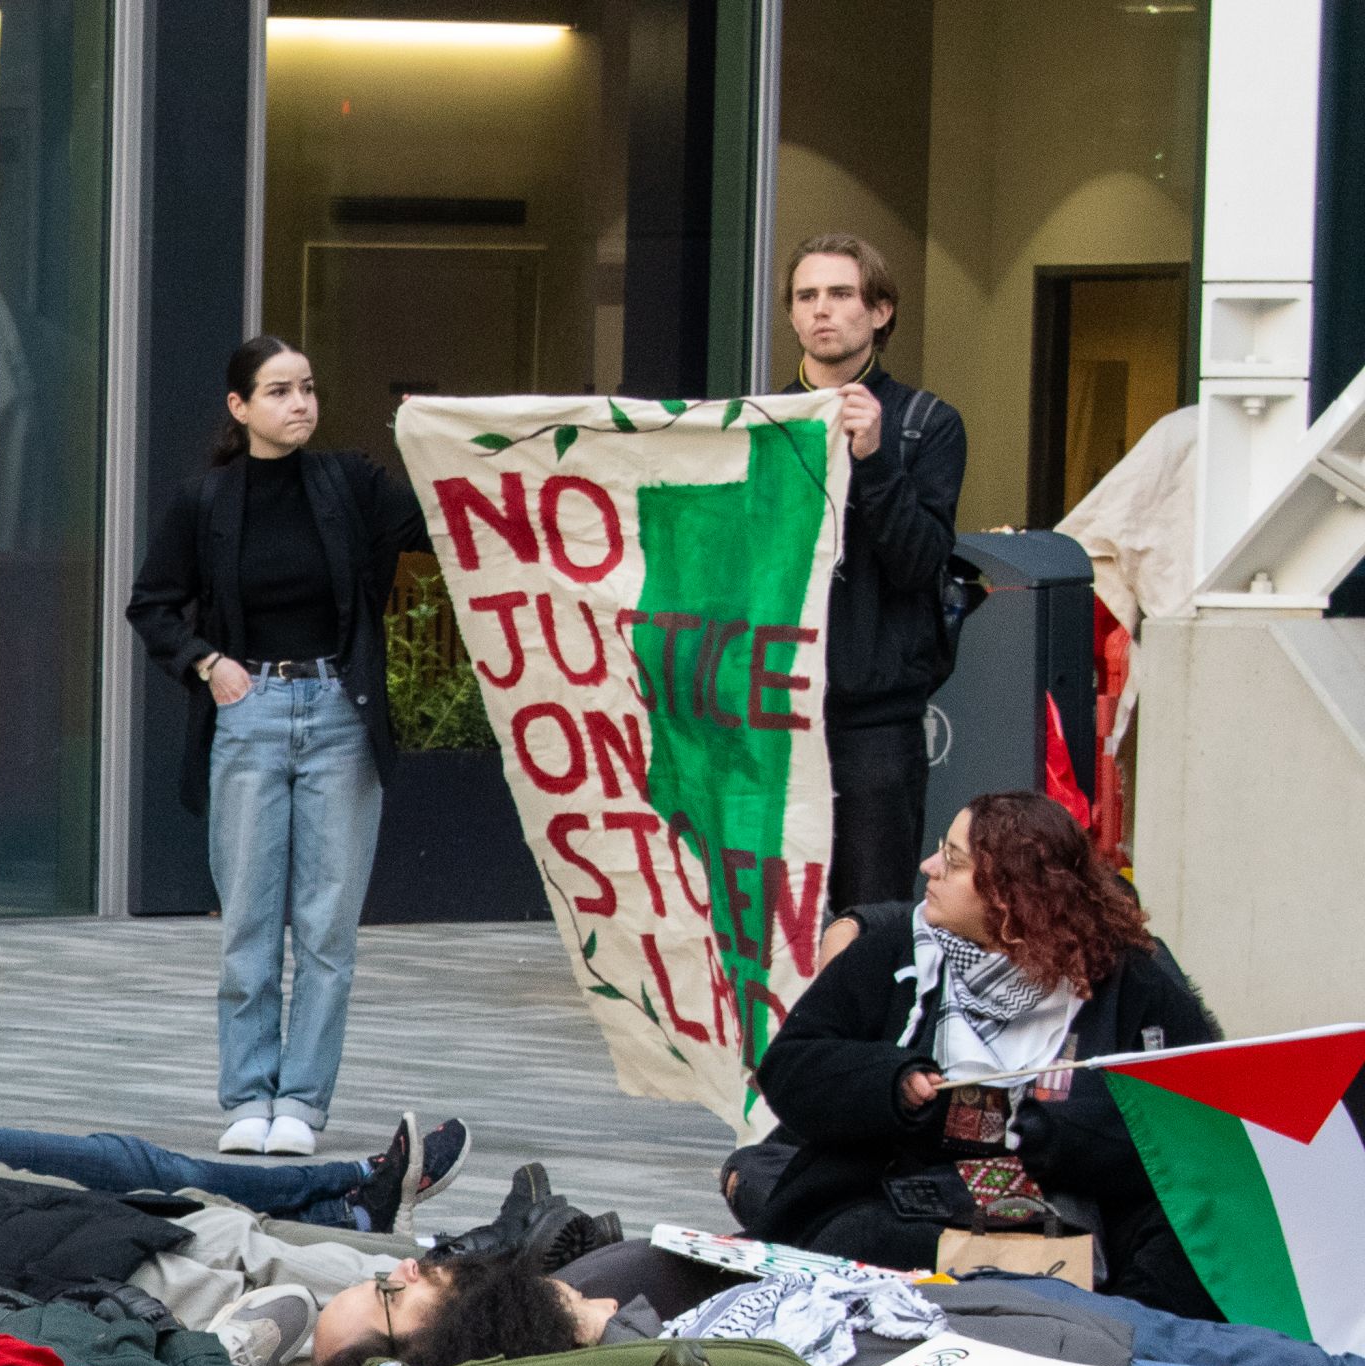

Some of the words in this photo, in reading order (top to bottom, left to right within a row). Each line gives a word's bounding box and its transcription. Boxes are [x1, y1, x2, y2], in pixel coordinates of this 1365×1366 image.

[433, 472, 624, 583] NO
[469, 591, 819, 731] JUSTICE
[511, 701, 650, 800] ON
[546, 810, 823, 978] STOEN
